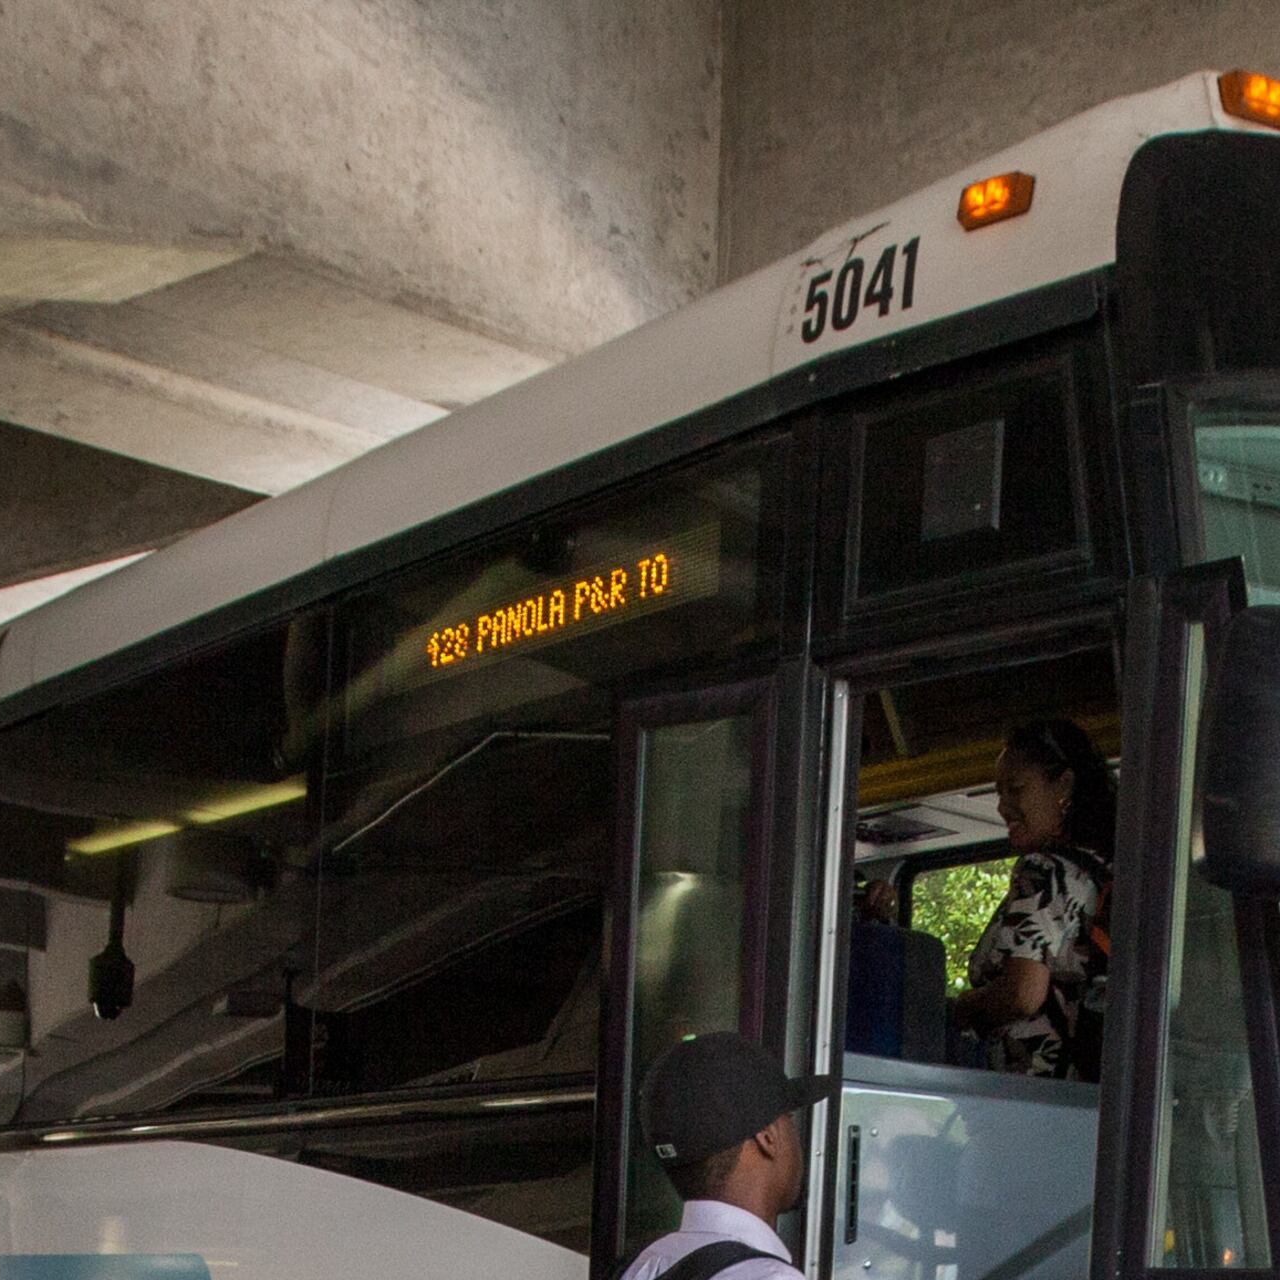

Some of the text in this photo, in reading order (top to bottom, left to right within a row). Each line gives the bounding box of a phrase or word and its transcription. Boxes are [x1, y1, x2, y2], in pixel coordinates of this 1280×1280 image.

[801, 236, 920, 343] 5041
[427, 552, 668, 668] 428 PANOLA P&R TO
